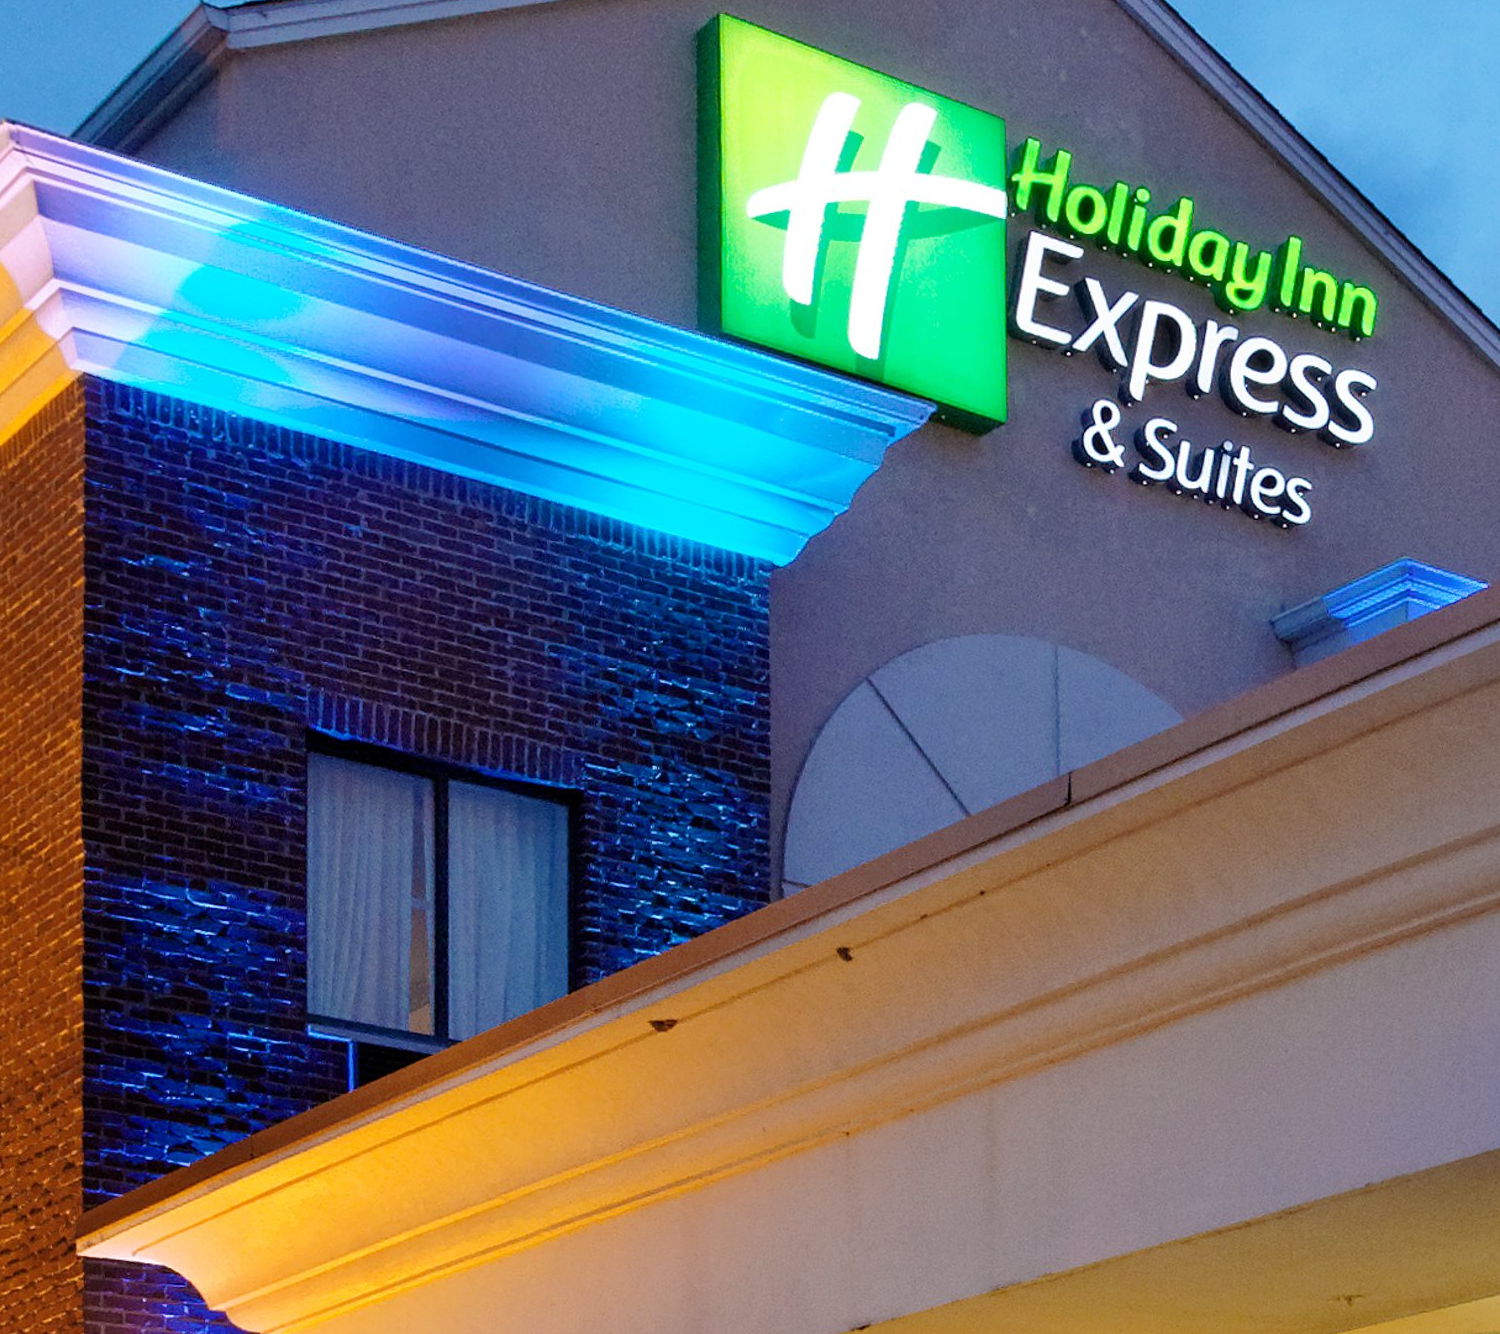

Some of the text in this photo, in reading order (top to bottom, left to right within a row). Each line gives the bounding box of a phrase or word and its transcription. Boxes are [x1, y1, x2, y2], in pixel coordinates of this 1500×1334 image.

[745, 90, 1008, 360] H
[1010, 136, 1379, 338] Holiday Inn
[1015, 230, 1378, 445] Express
[1082, 398, 1313, 525] & Suites
